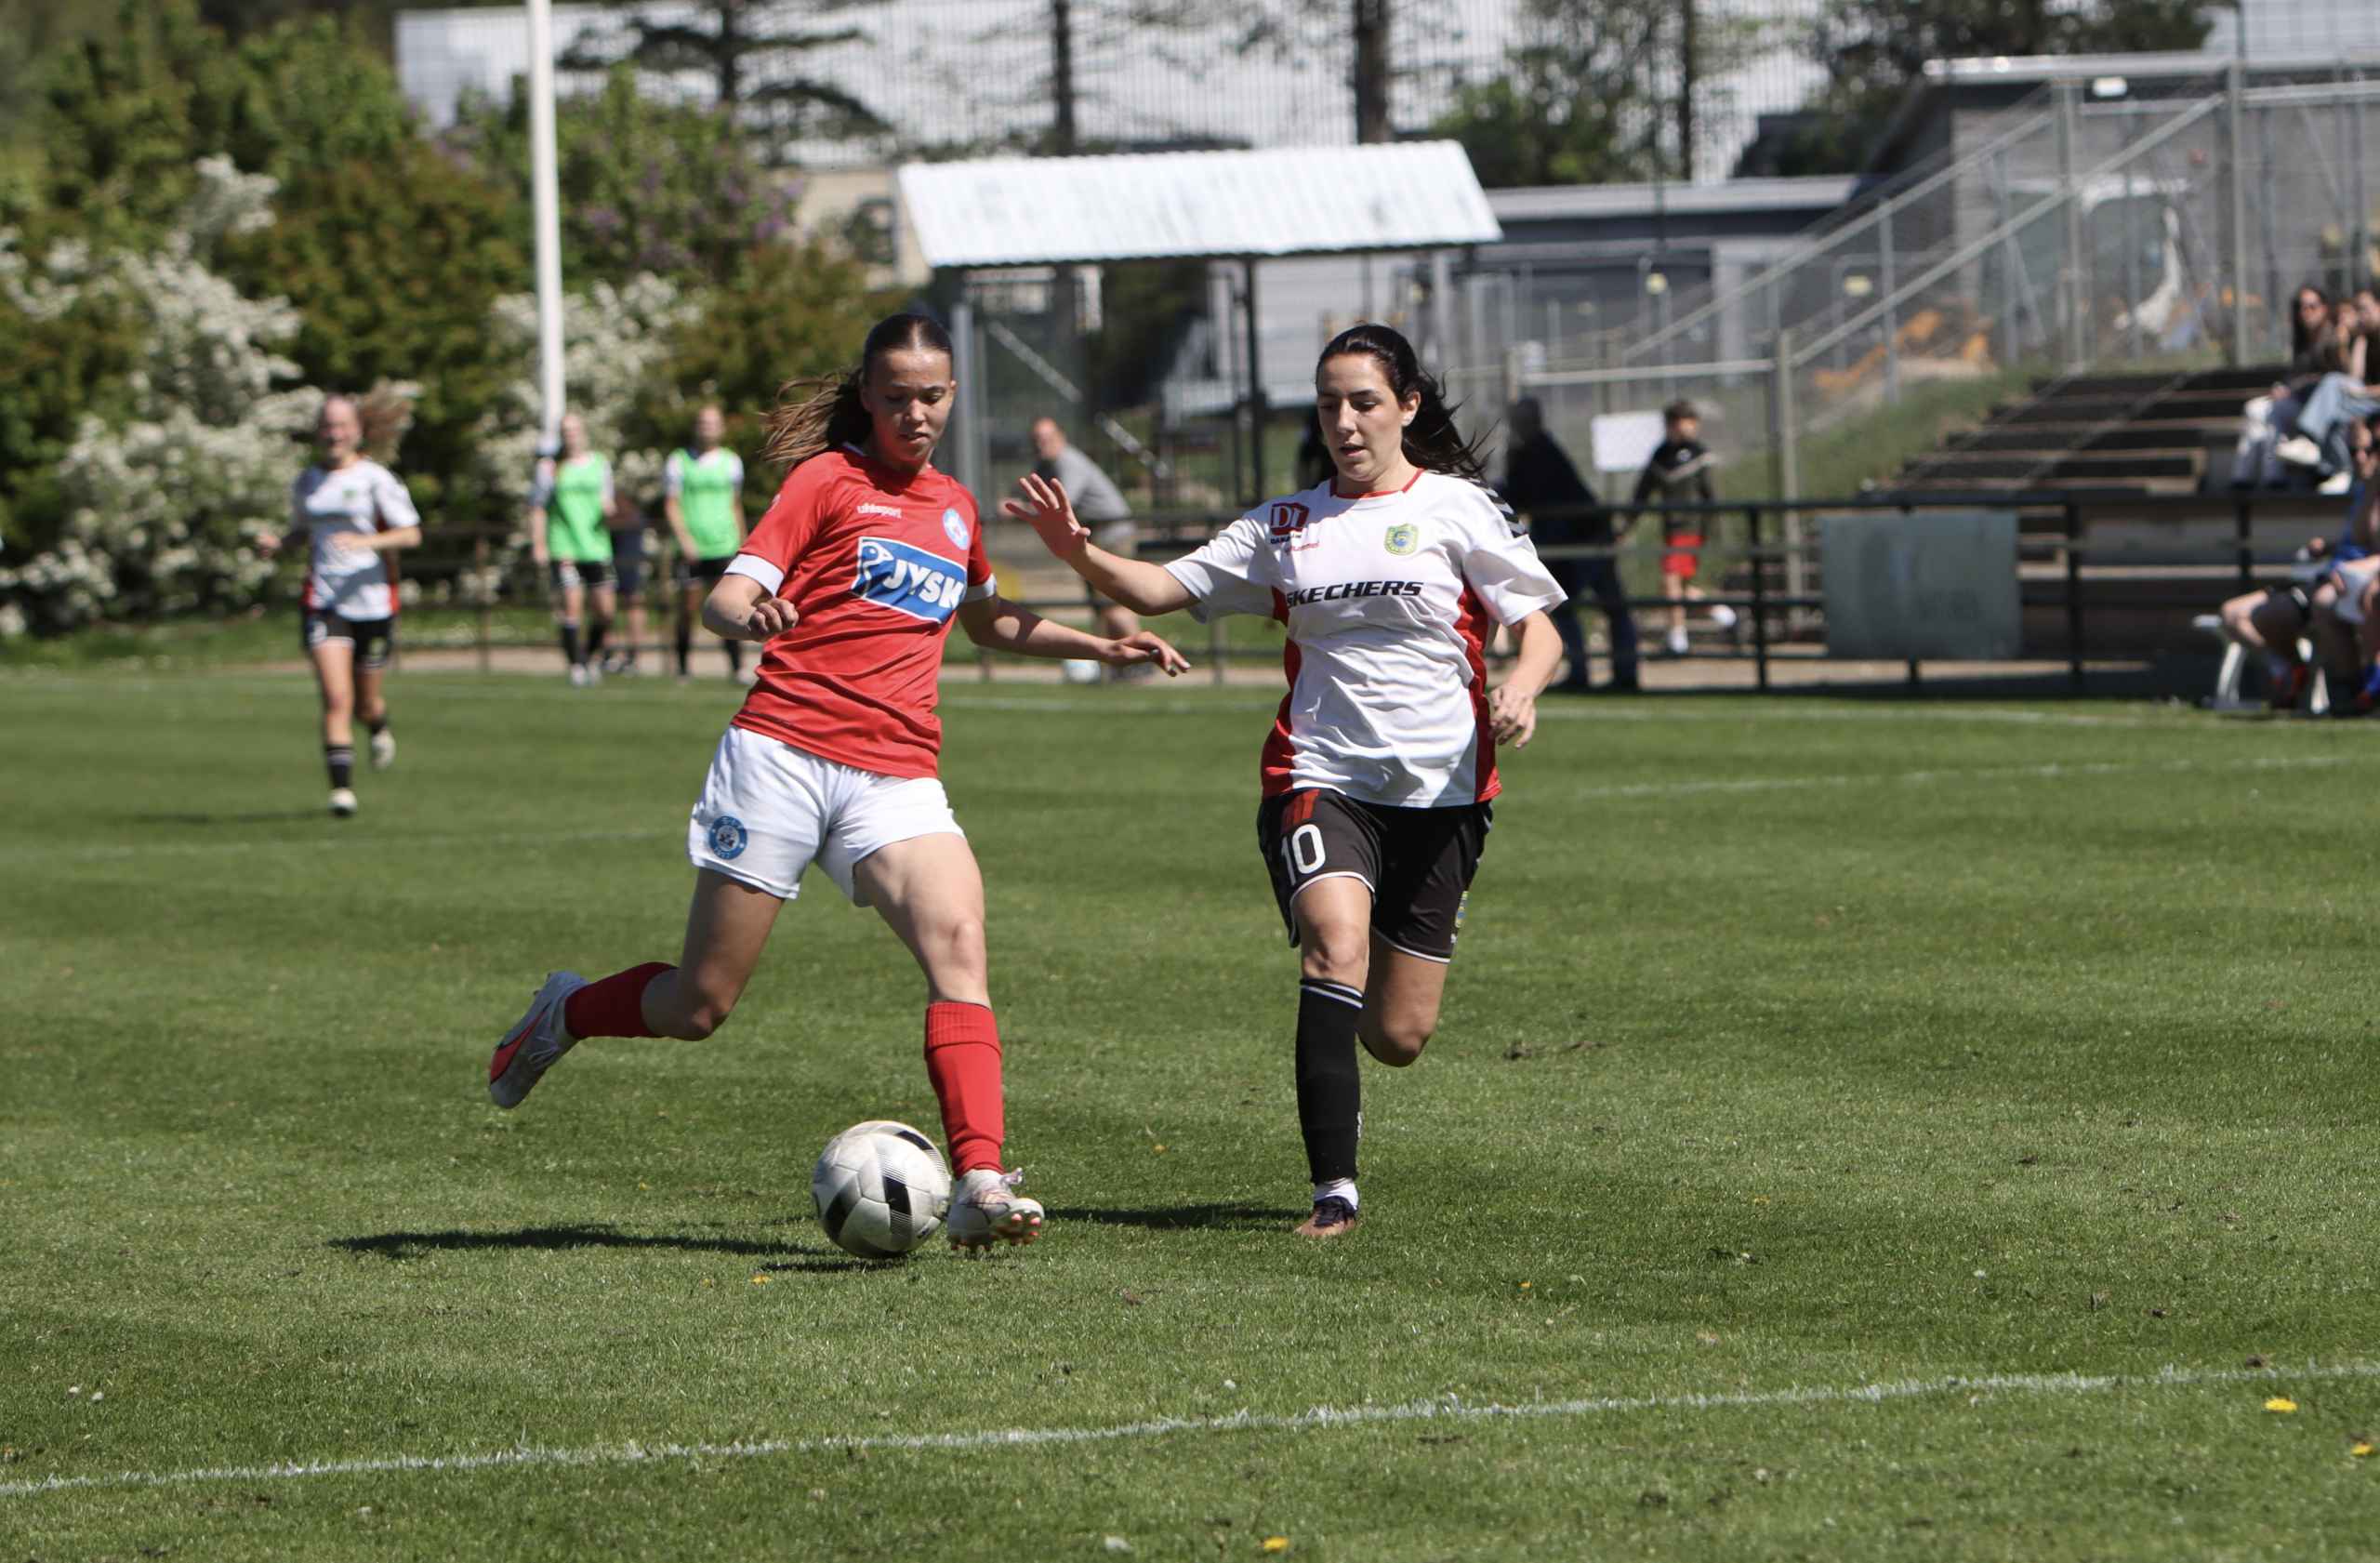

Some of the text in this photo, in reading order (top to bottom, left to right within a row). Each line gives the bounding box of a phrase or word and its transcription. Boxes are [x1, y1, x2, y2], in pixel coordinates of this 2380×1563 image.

[884, 560, 964, 610] JYSK
[1287, 580, 1424, 607] SKECHERS
[1281, 824, 1326, 885] 10
